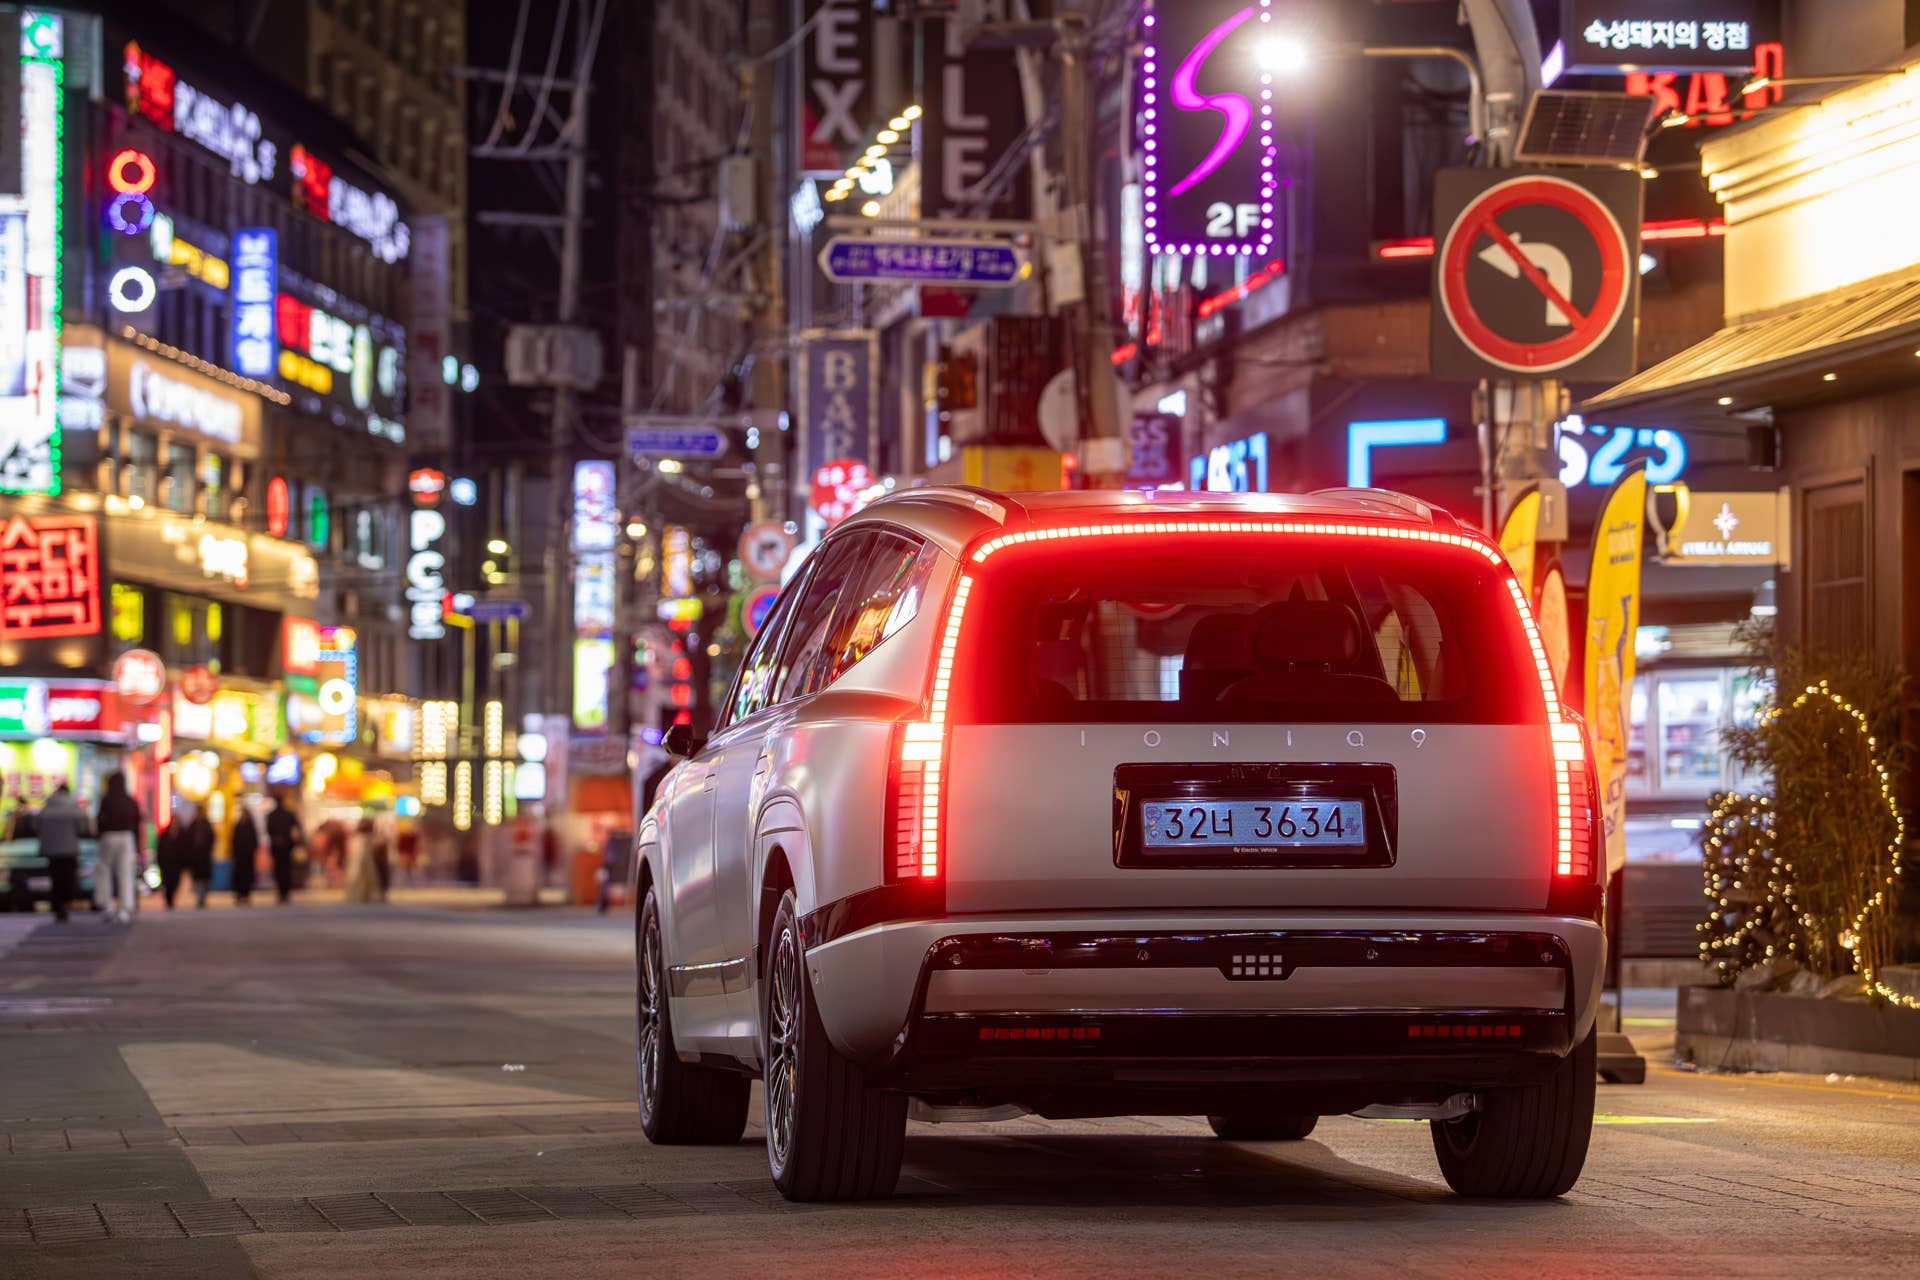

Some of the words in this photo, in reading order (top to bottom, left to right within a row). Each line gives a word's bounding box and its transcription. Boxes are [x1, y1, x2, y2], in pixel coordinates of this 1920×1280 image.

[1584, 19, 1698, 50] 숙성돼지의
[1702, 20, 1750, 50] 정점
[1205, 201, 1262, 238] 2F
[1080, 729, 1366, 749] IONIQ
[1410, 728, 1426, 749] 9
[1164, 806, 1233, 840] 32너
[1253, 805, 1346, 840] 3634
